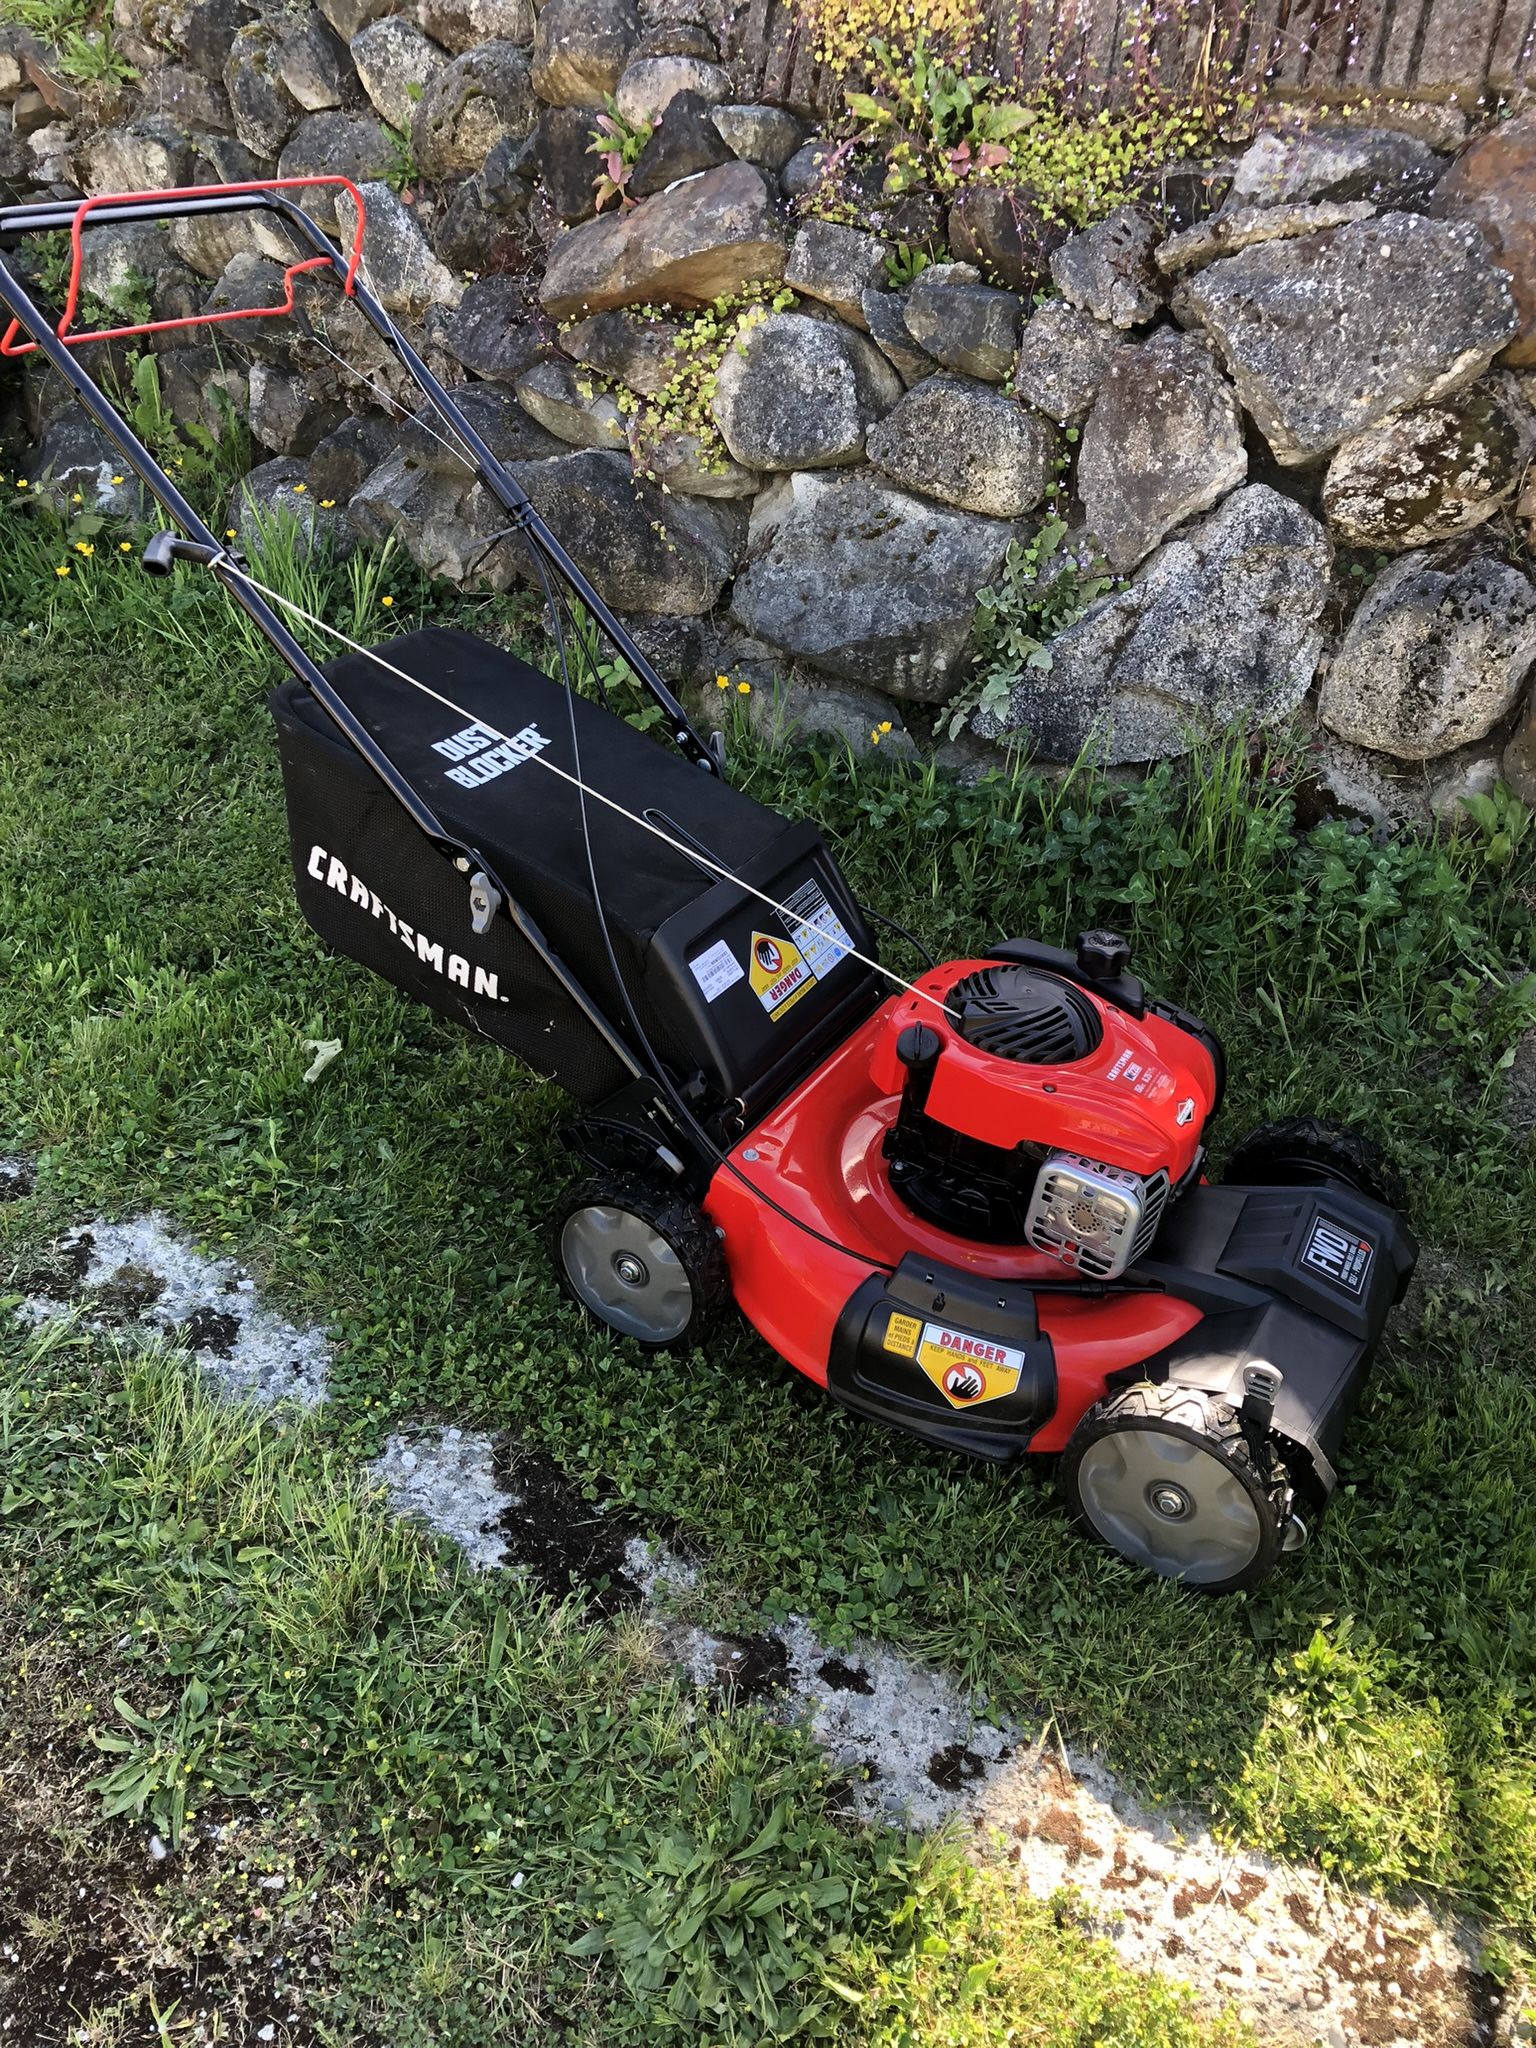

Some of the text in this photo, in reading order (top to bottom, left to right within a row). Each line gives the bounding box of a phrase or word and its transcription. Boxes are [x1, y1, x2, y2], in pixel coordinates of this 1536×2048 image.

[430, 722, 503, 762] DUST
[444, 727, 552, 789] BLOCKER
[769, 967, 802, 1001] DANGER
[1306, 1228, 1348, 1276] FWD
[894, 1317, 917, 1329] GARDER
[894, 1325, 912, 1336] MAINS
[929, 1345, 944, 1353] KEEP
[946, 1350, 965, 1360] HANDS
[979, 1359, 993, 1368] FEET
[996, 1364, 1011, 1374] AWAY
[940, 1331, 1007, 1363] DANGER
